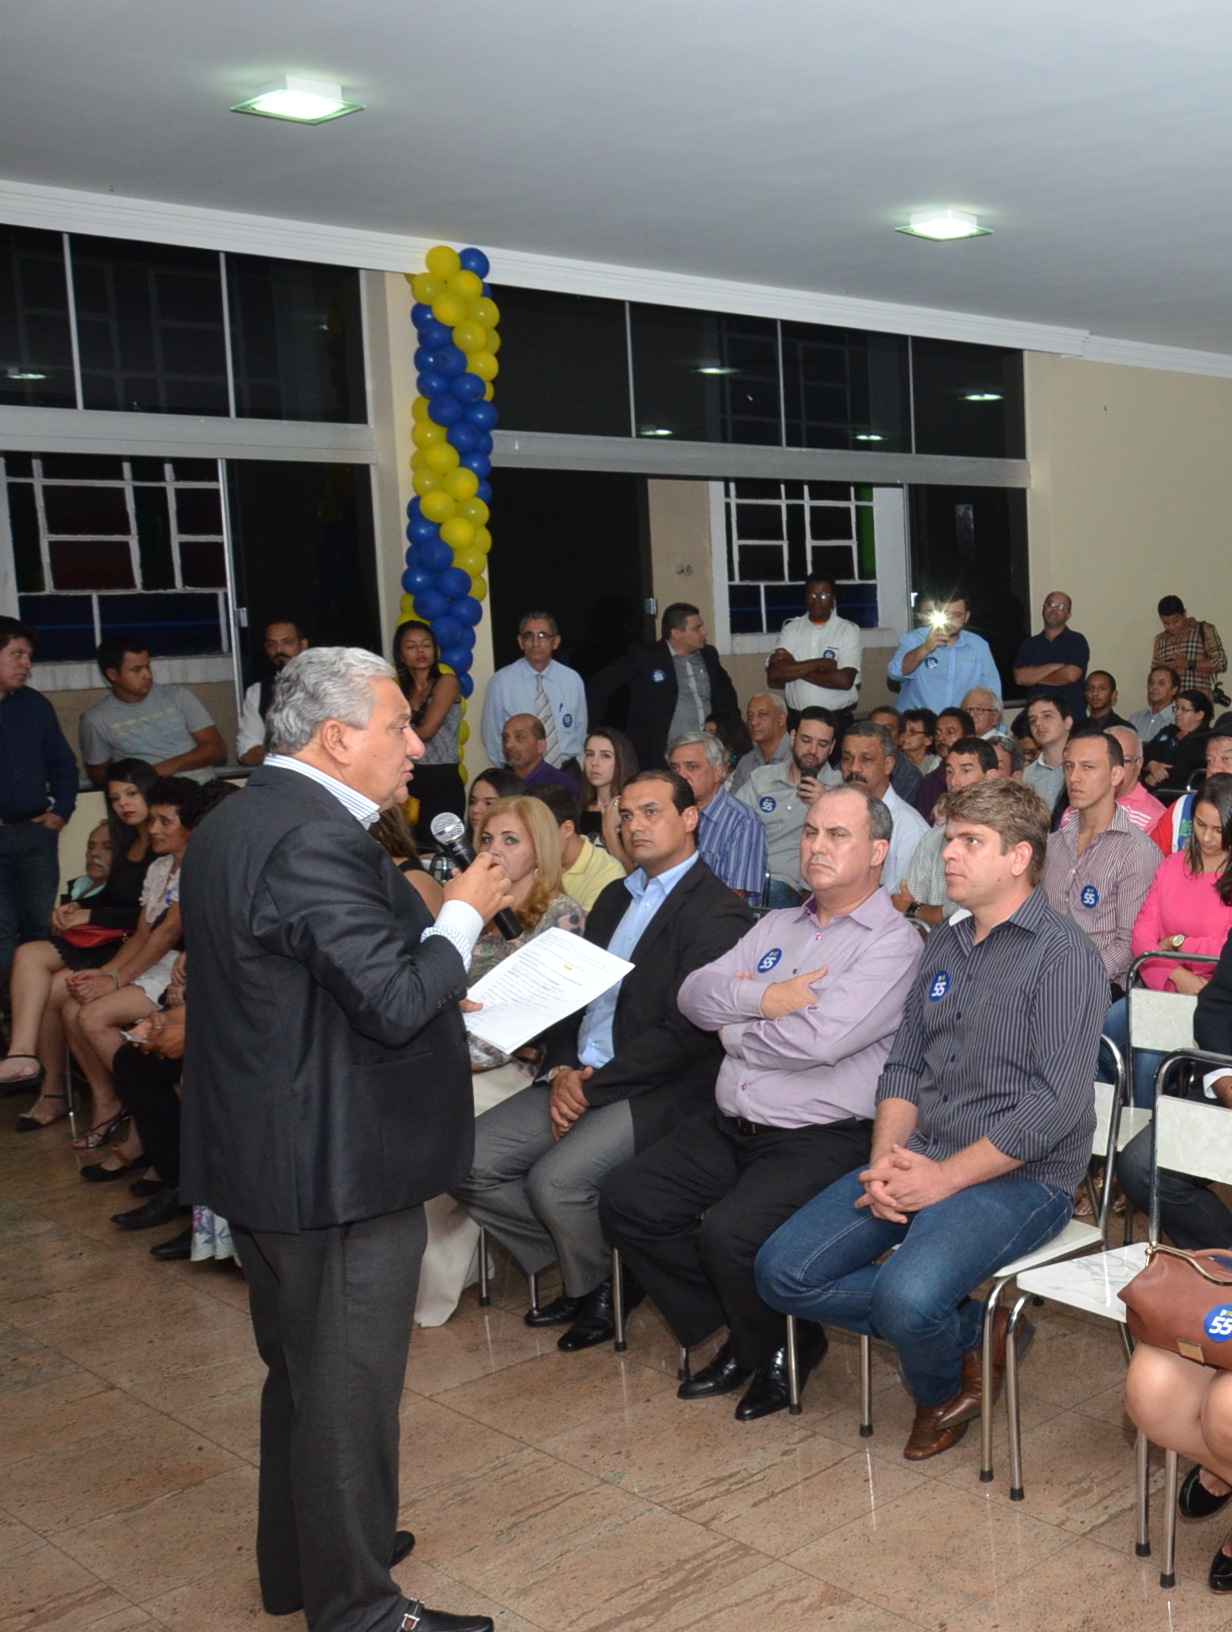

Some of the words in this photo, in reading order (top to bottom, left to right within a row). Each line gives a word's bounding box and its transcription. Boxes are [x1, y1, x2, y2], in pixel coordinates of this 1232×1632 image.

[762, 801, 774, 811] 55
[1083, 893, 1096, 905] 55
[760, 957, 777, 969] 55
[931, 981, 946, 997] 55
